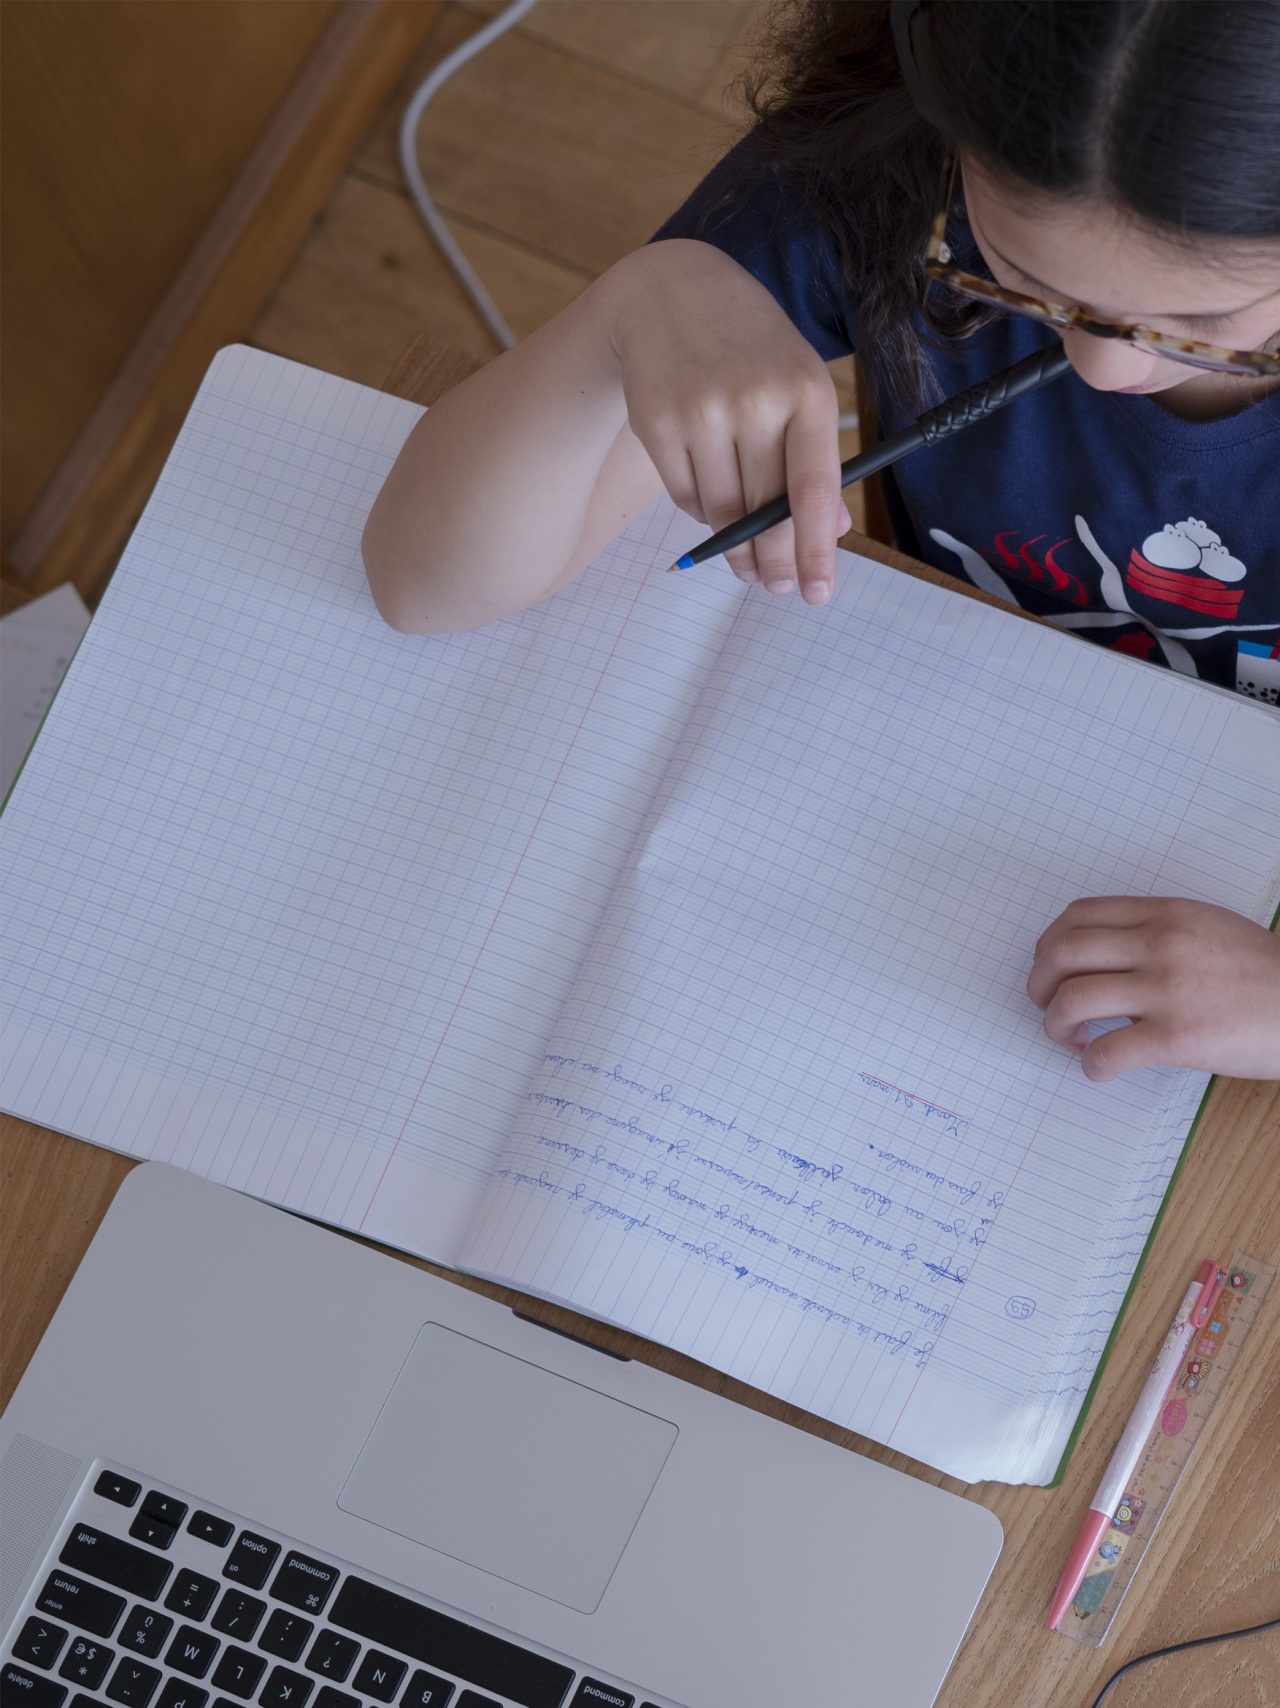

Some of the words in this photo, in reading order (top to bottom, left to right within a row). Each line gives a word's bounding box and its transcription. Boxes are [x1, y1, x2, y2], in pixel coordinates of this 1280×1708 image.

[923, 1103, 968, 1136] Mardi
[914, 1341, 933, 1367] Je
[78, 1532, 96, 1545] shift
[242, 1538, 268, 1554] option
[229, 1564, 238, 1572] alt
[289, 1559, 330, 1581] command
[54, 1578, 79, 1594] return
[45, 1599, 62, 1610] enter
[185, 1644, 199, 1659] M
[8, 1671, 33, 1689] delete
[237, 1666, 243, 1679] L
[373, 1669, 386, 1683] N
[280, 1686, 292, 1699] K
[422, 1691, 432, 1703] B
[584, 1685, 625, 1706] command
